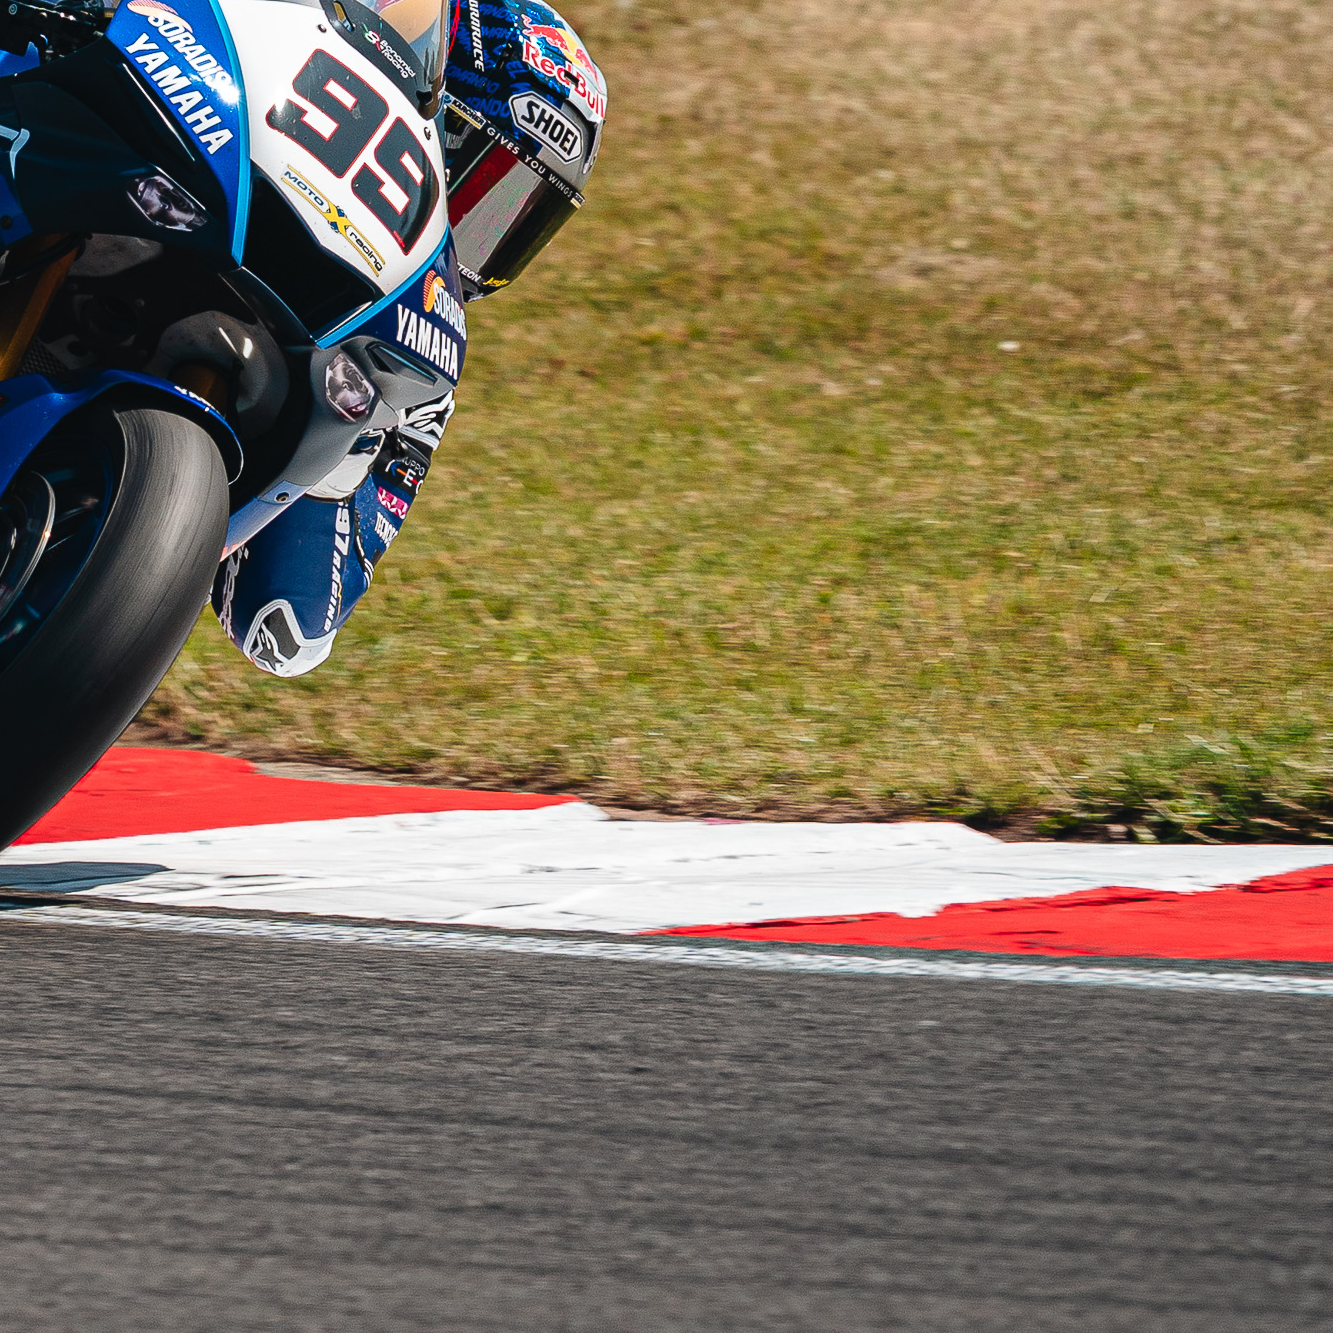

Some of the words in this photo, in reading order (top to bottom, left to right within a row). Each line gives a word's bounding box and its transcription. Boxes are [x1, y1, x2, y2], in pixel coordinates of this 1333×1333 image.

[125, 33, 234, 155] YAMAHA
[382, 48, 410, 78] Racing
[522, 38, 572, 86] Red
[571, 72, 606, 119] Bull
[265, 49, 440, 255] 99
[486, 127, 520, 155] GIVES
[524, 153, 546, 175] YOU
[548, 175, 573, 199] WINGS
[521, 100, 579, 155] SHOEI
[284, 170, 325, 207] MOTO
[348, 230, 385, 272] racing
[456, 262, 481, 283] TEON
[396, 303, 459, 381] YAMAHA
[324, 502, 350, 633] 97RACING
